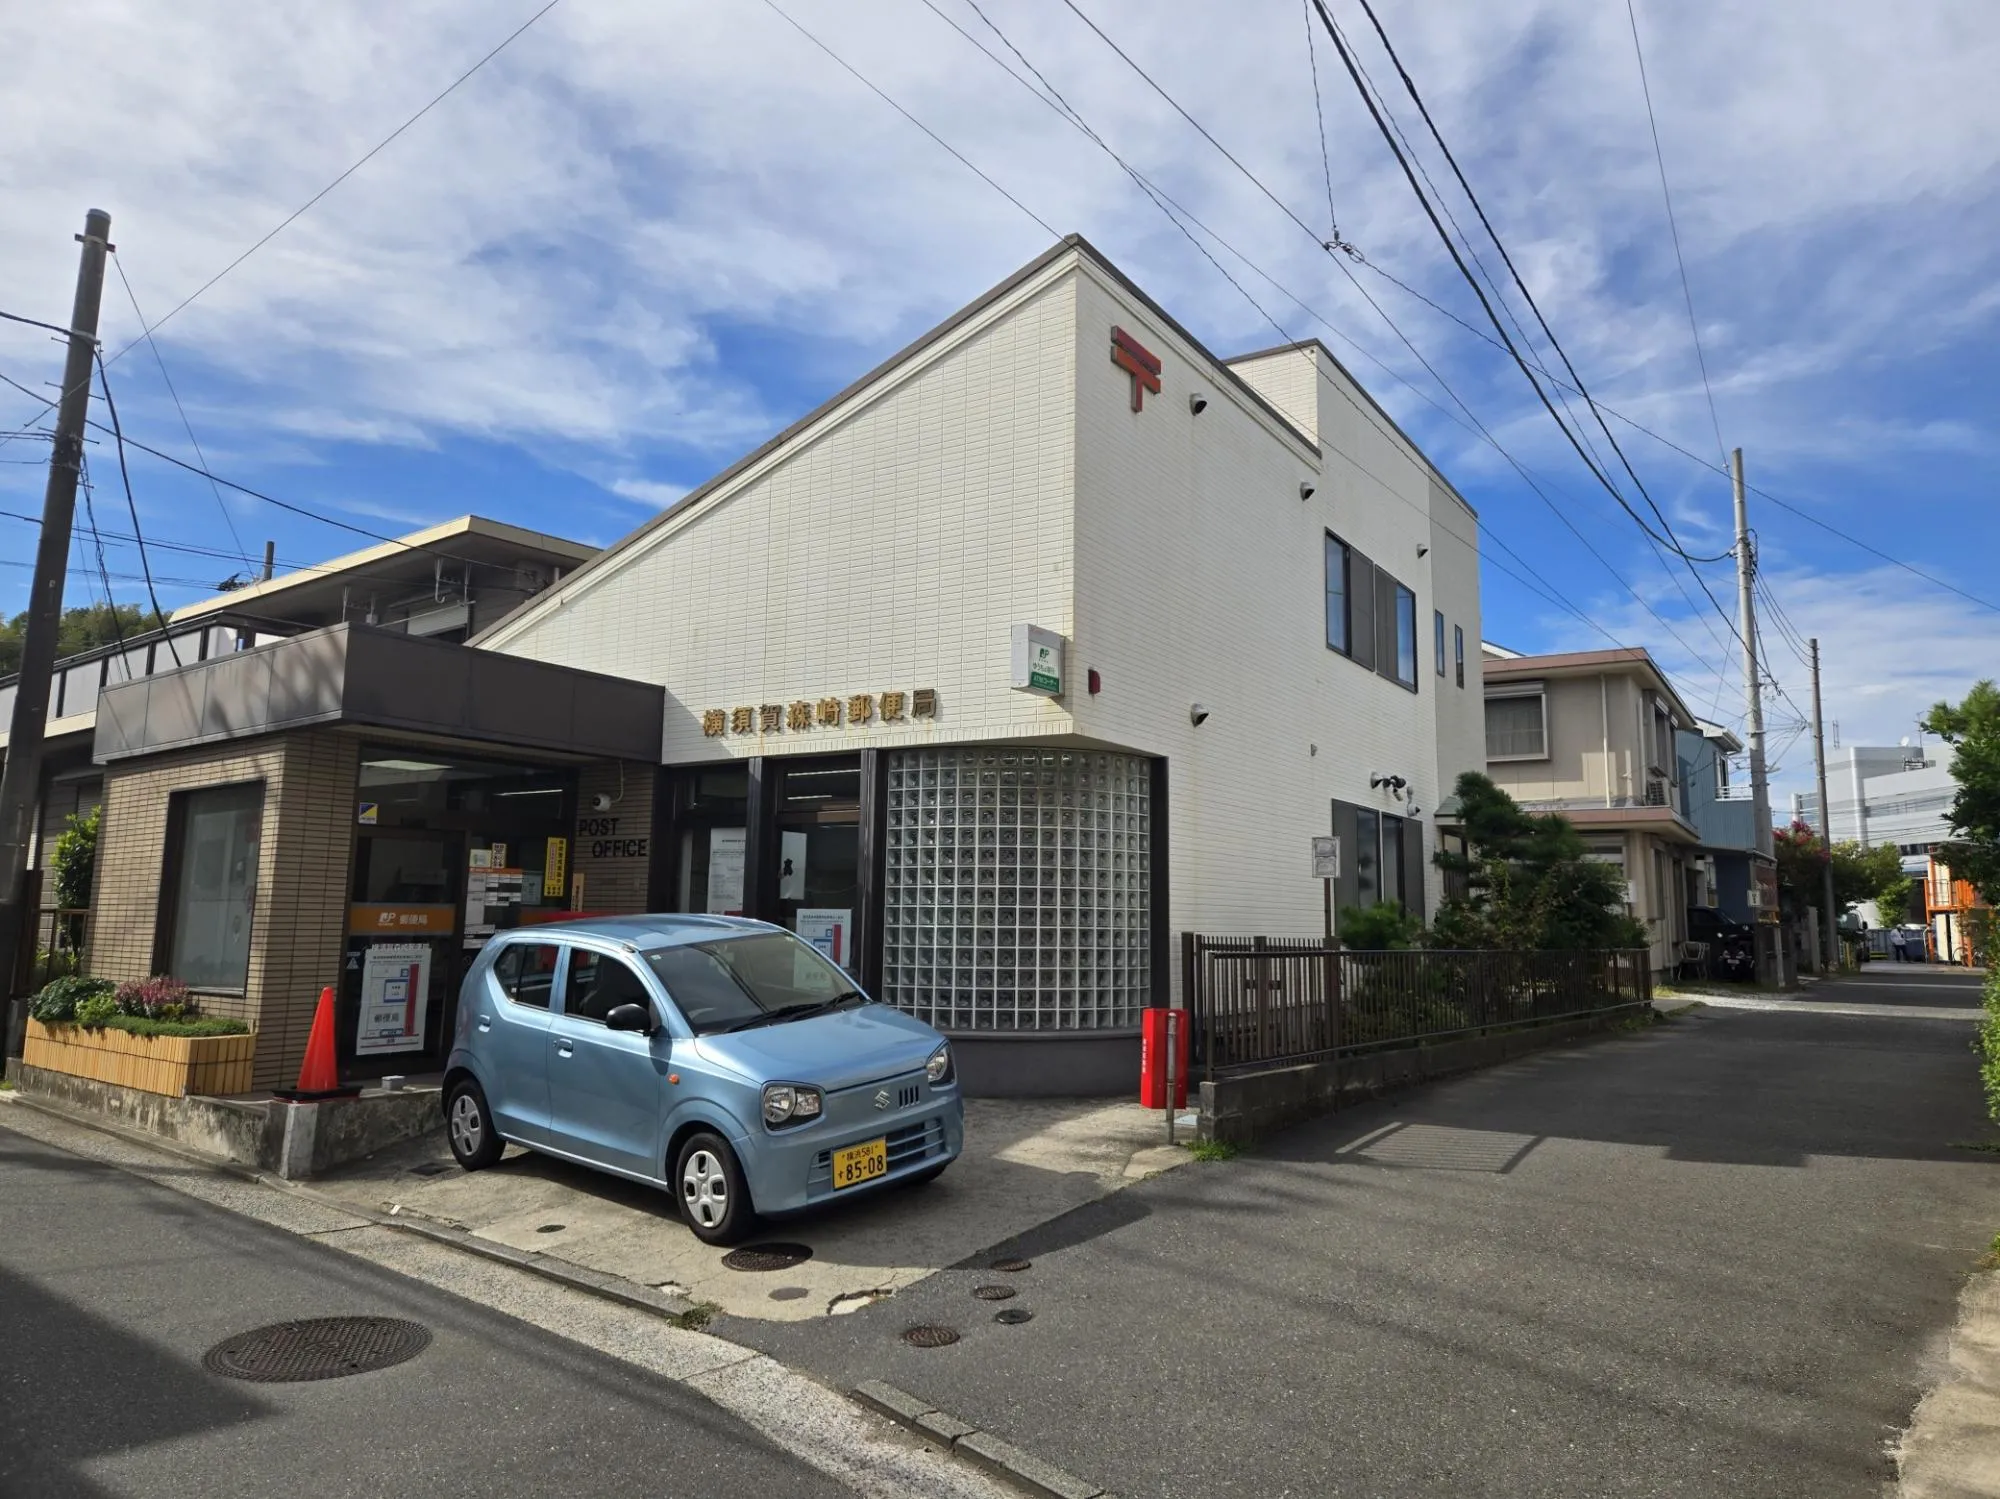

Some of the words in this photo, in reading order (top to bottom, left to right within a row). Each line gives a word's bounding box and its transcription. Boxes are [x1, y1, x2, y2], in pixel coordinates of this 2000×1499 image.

[703, 689, 937, 737] 横須賀森崎郵便局
[578, 817, 620, 836] POST
[592, 839, 648, 858] OFFICE
[399, 914, 428, 926] 郵便局
[374, 1012, 399, 1024] 郵便局
[846, 1155, 883, 1180] 85-08
